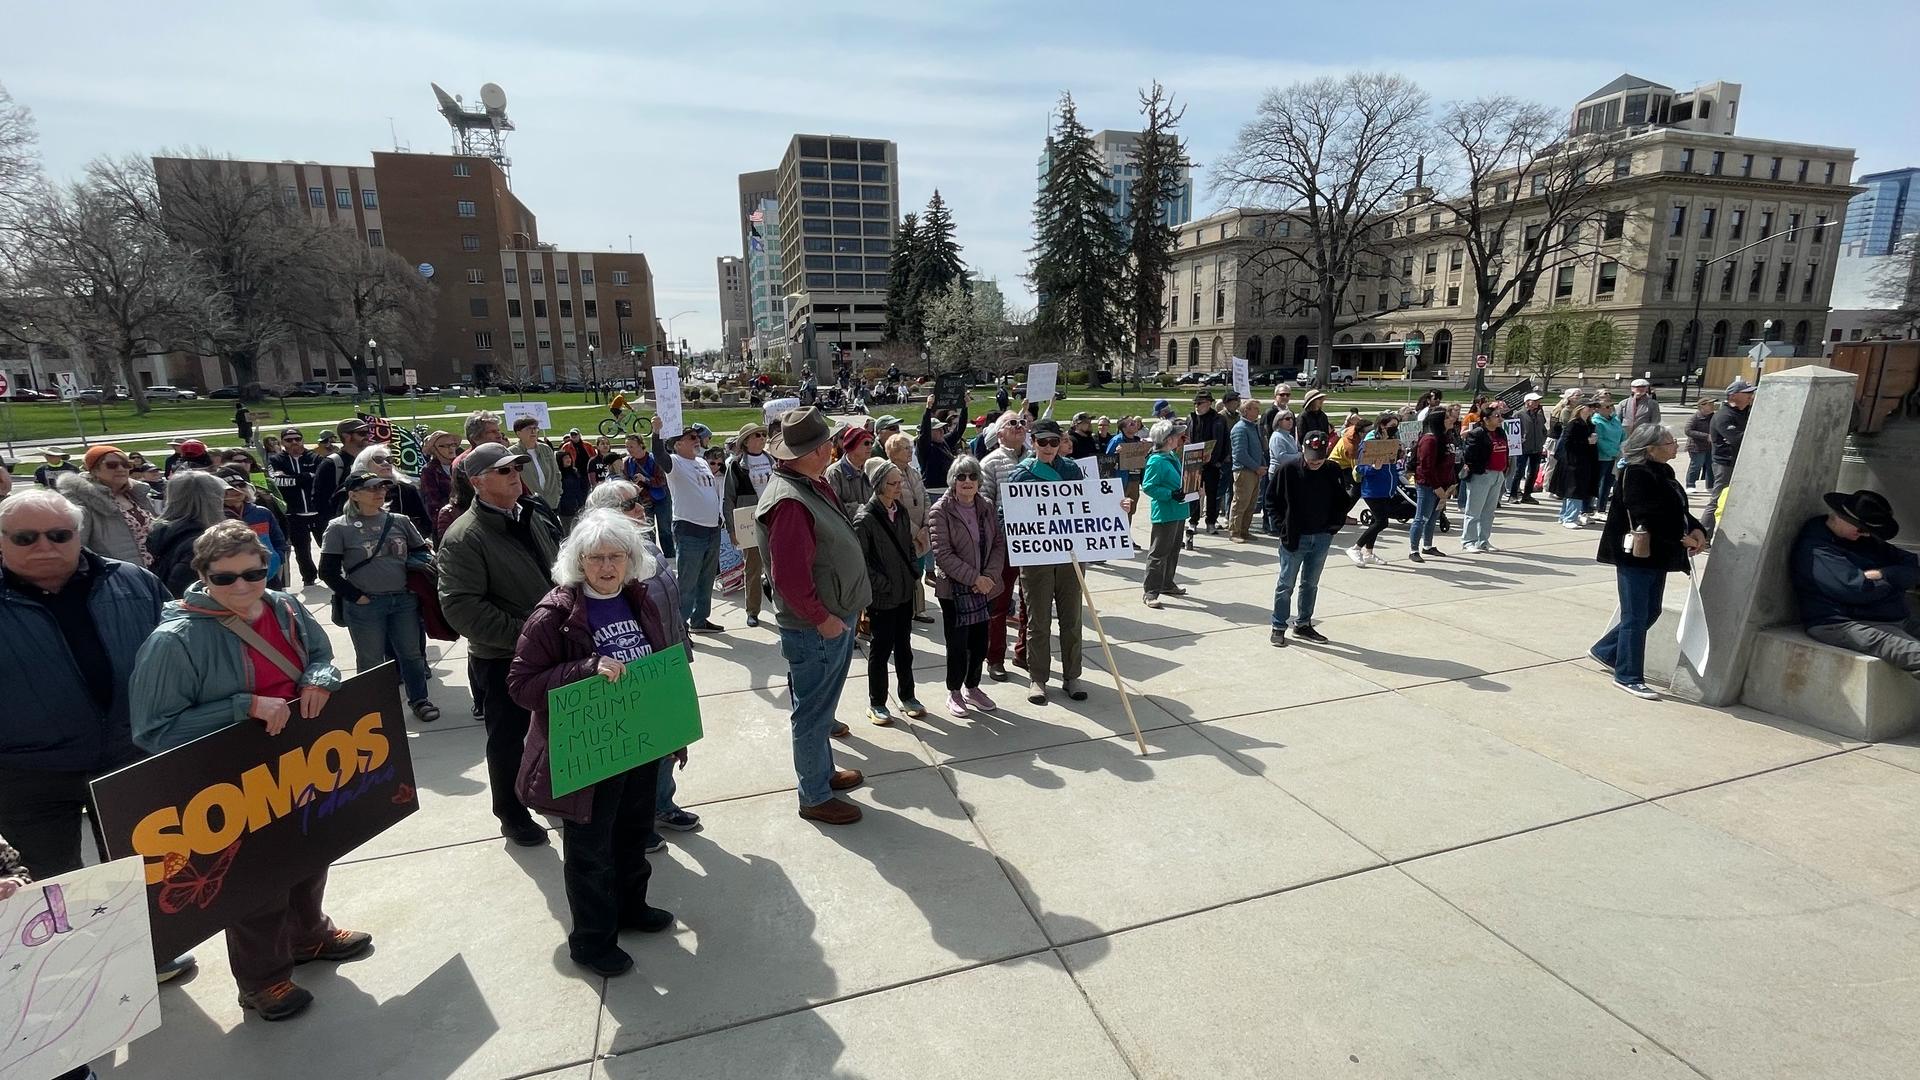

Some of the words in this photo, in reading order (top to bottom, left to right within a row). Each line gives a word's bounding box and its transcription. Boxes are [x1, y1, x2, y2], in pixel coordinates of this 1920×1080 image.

[1008, 483, 1083, 498] DIVISION
[1100, 480, 1113, 494] &
[1037, 501, 1091, 516] HATE
[1006, 522, 1046, 536] MAKE
[1048, 516, 1125, 535] AMERICA
[1011, 538, 1074, 553] SECOND
[1085, 535, 1130, 551] RATE
[592, 620, 643, 647] MACKIN
[555, 690, 582, 713] NO
[589, 656, 668, 705] EMPATHY
[131, 711, 390, 885] SOMOS
